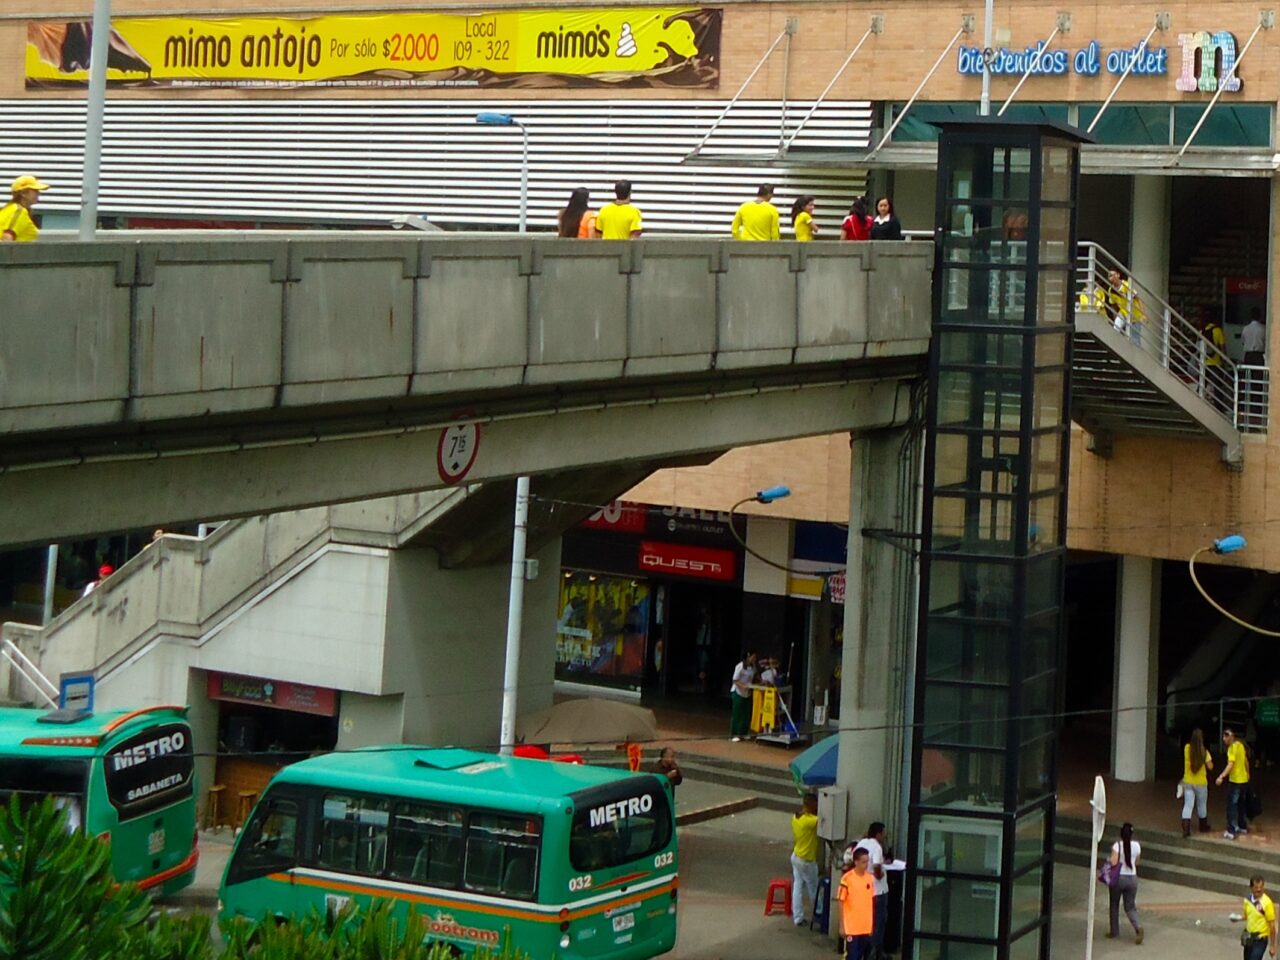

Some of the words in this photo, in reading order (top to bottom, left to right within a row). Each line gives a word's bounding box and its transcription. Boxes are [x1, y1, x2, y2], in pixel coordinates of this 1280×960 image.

[465, 17, 497, 38] Local
[164, 27, 231, 68] mimo
[240, 25, 322, 74] antojo
[330, 38, 350, 58] Por
[354, 38, 377, 57] sólo
[486, 40, 510, 61] 322
[1074, 41, 1100, 75] al
[1106, 41, 1169, 75] outlet
[643, 554, 720, 573] QUEST
[113, 732, 185, 771] METRO
[127, 773, 183, 800] SABANETA
[590, 794, 653, 827] METRO
[654, 852, 674, 869] 032
[569, 875, 592, 892] 032
